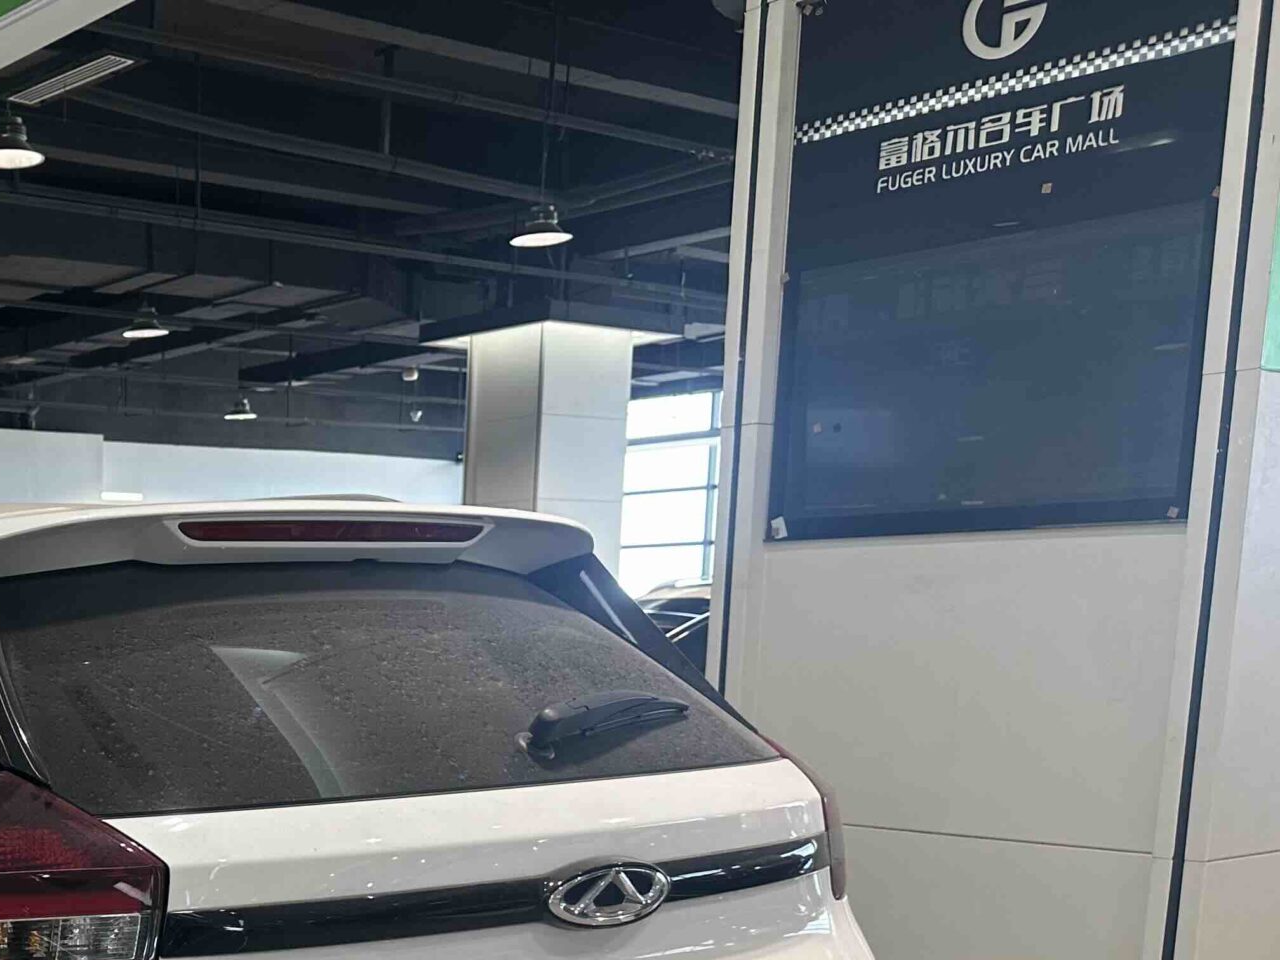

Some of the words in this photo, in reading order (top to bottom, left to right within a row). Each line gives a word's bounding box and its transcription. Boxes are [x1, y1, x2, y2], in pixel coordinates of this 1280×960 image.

[876, 166, 936, 193] FUGER
[941, 148, 1016, 180] LUXURY
[1019, 140, 1059, 163] CAR
[1065, 127, 1120, 155] MALL
[878, 84, 1125, 170] 富格尔名车广场
